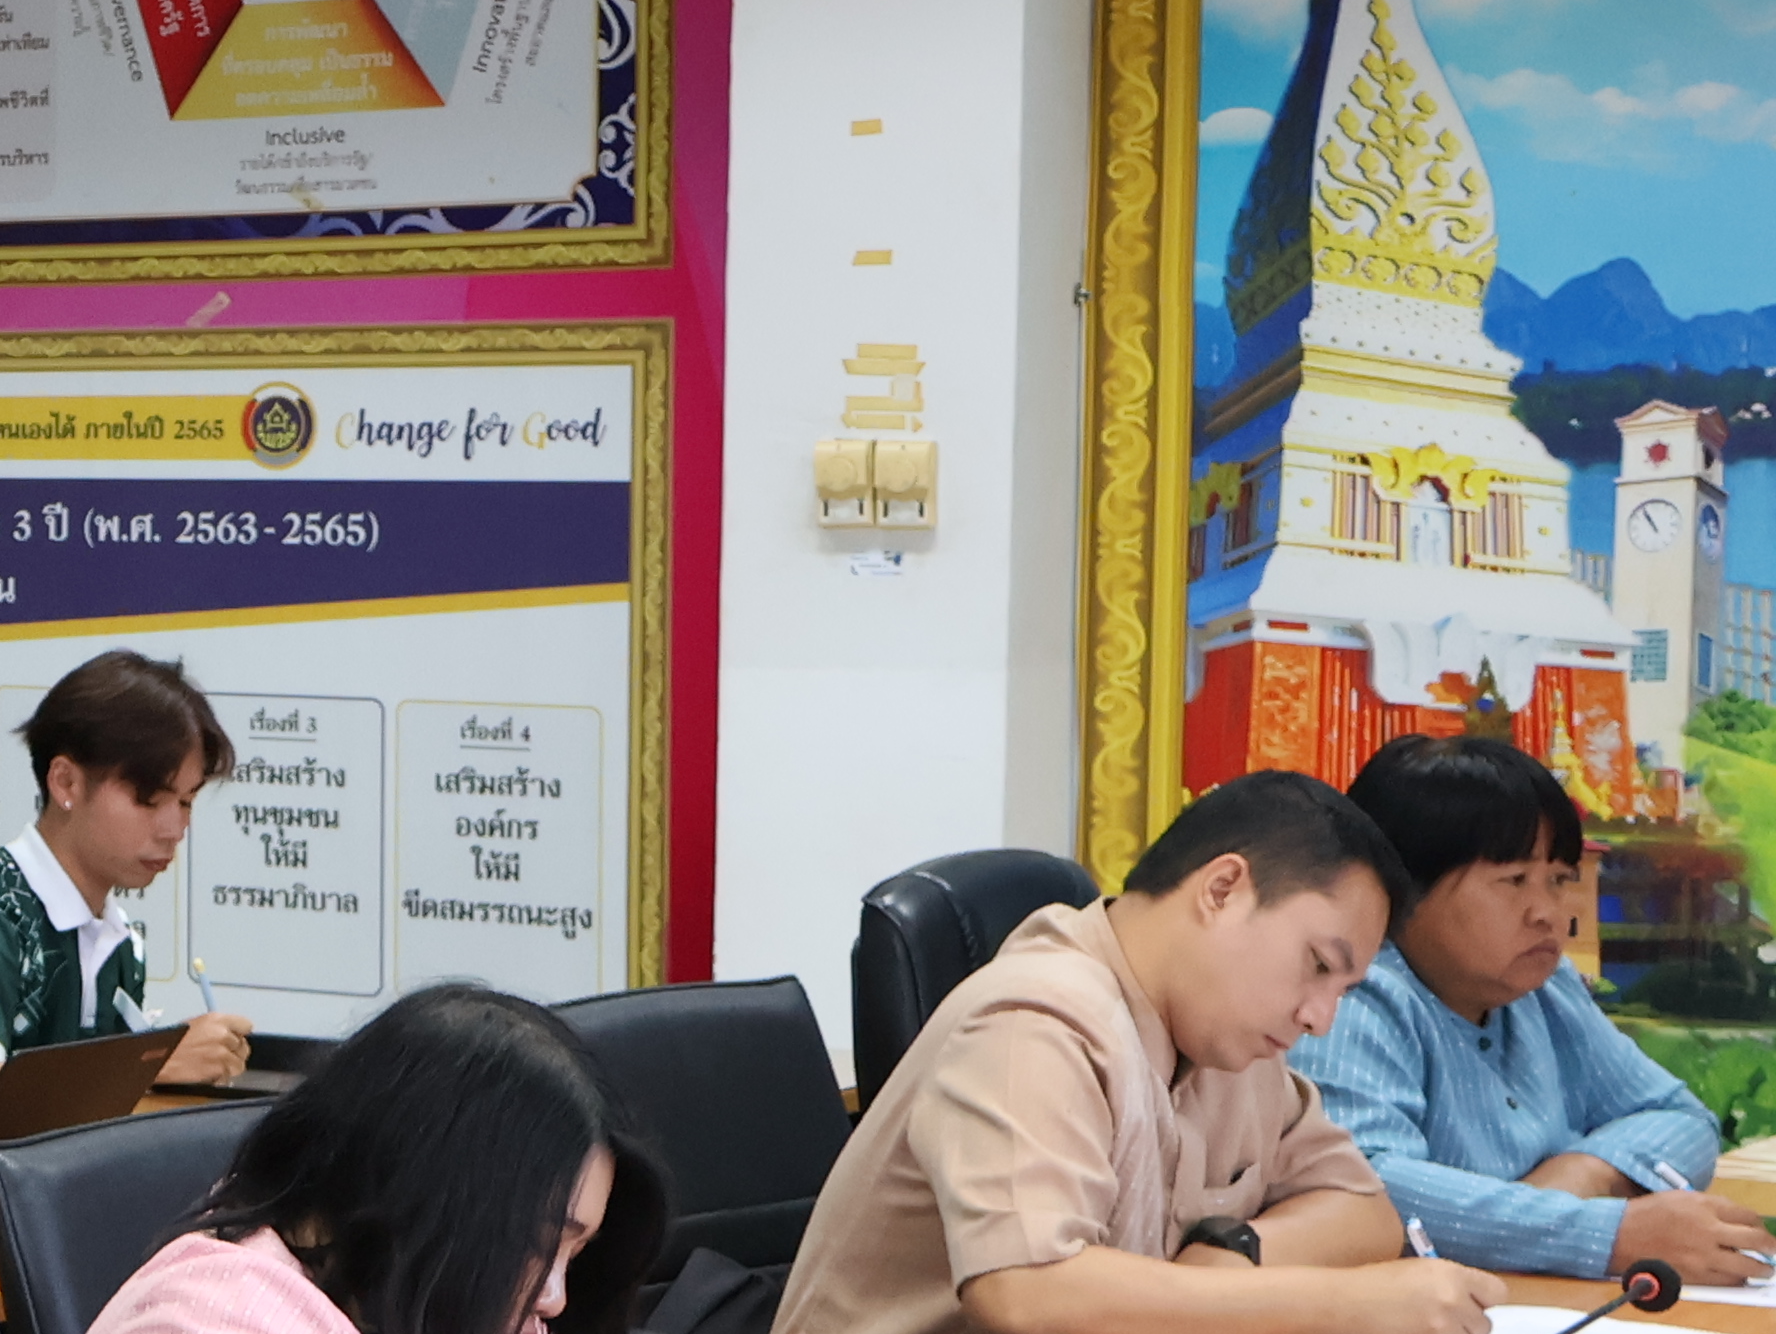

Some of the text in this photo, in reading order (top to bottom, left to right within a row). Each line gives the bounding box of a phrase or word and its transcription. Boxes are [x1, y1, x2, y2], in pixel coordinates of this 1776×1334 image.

[265, 126, 346, 146] Inclusive
[84, 411, 164, 442] ภายในปี
[174, 418, 225, 441] 2565
[335, 407, 606, 460] Change for Good
[13, 509, 33, 542] 3
[44, 502, 69, 542] ปี
[84, 507, 162, 548] (พ.ศ.
[306, 717, 318, 733] 3
[459, 714, 531, 742] เรื่องที่ 4
[434, 766, 562, 799] เสริมสร้าง
[232, 802, 340, 837] ทุนชุมชน
[455, 808, 539, 840] องค์กร
[260, 834, 308, 869] ให้มี
[470, 844, 521, 881] ให้มี
[213, 883, 359, 914] ธรรมาภิบาล
[402, 888, 593, 940] ขีดสมรรถนะสูง
